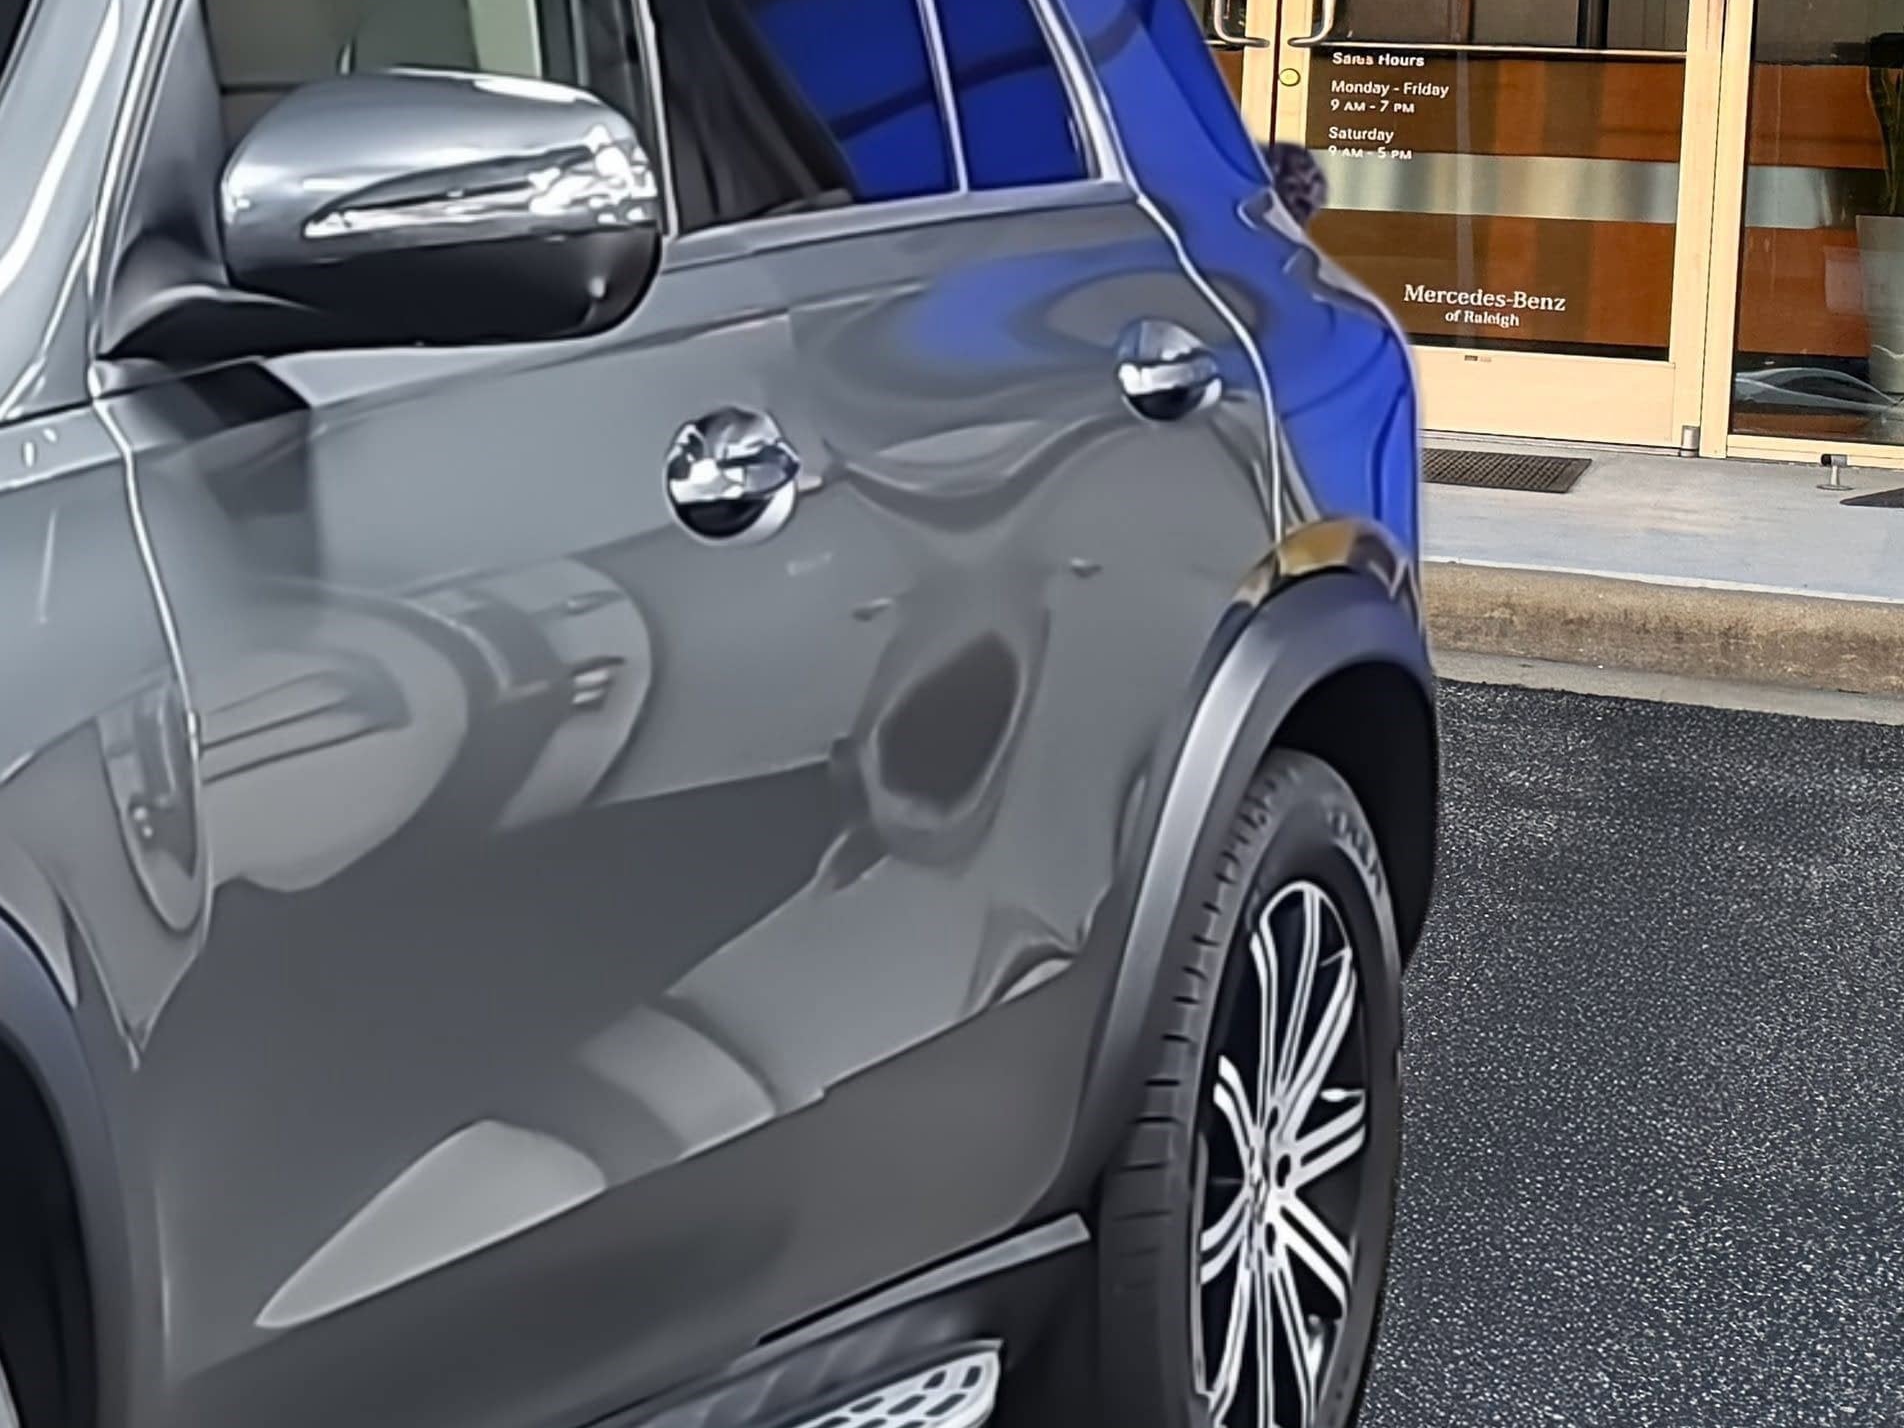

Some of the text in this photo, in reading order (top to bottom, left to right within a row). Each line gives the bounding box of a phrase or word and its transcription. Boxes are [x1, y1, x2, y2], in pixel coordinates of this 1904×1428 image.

[1378, 53, 1425, 67] Hours
[1331, 80, 1390, 97] Monday
[1403, 82, 1450, 98] Friday
[1330, 99, 1340, 111] 9
[1343, 102, 1366, 112] AM
[1379, 100, 1389, 112] 7
[1393, 103, 1415, 113] PM
[1328, 126, 1395, 144] Saturday
[1328, 145, 1338, 157] 9
[1341, 148, 1365, 158] AM
[1377, 147, 1387, 159] 5
[1391, 150, 1413, 160] PM
[1403, 283, 1567, 312] Mercedes-Benz
[1445, 309, 1462, 322] of
